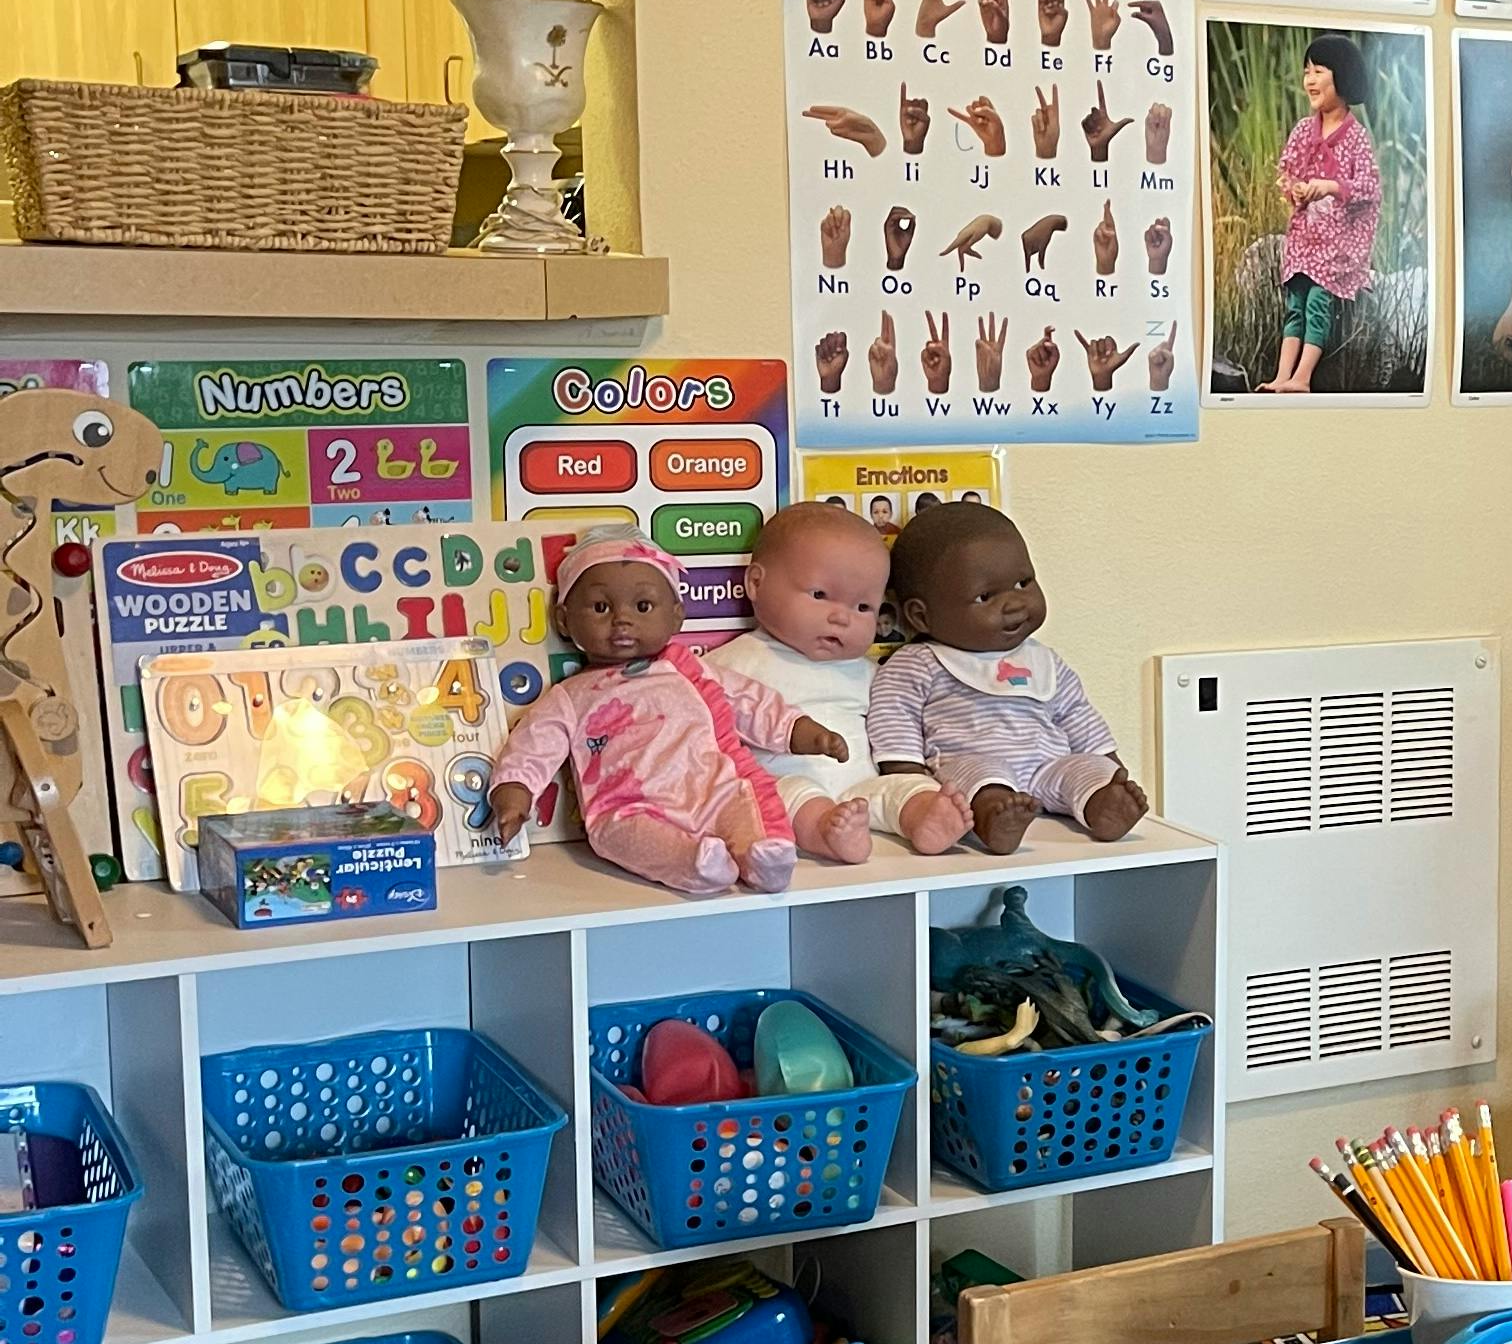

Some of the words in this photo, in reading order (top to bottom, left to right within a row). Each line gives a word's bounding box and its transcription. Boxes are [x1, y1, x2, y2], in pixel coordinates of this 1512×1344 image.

[808, 37, 840, 59] Aa
[865, 41, 894, 61] Bb
[923, 44, 951, 65] Cc
[984, 47, 1012, 68] Dd
[1041, 51, 1064, 71] Ee
[1094, 54, 1114, 74] Ff
[1146, 57, 1174, 82] Gg
[823, 159, 854, 181] Hh
[905, 161, 920, 182] Ii
[970, 165, 990, 189] Jj
[1034, 167, 1061, 187] Kk
[1092, 169, 1109, 188] Ll
[1140, 170, 1174, 191] Mm
[818, 274, 849, 295] Nn
[881, 276, 913, 296] Oo
[955, 276, 981, 301] Pp
[1025, 277, 1060, 302] Qq
[1095, 279, 1118, 298] Rr
[1150, 280, 1170, 298] Ss
[200, 369, 405, 416] Numbers
[553, 365, 735, 415] Colors
[820, 398, 841, 418] Tt
[871, 398, 900, 418] Uu
[925, 398, 952, 417] Vv
[972, 397, 1012, 417] Ww
[1032, 397, 1059, 416] Xx
[1092, 397, 1117, 420] Yy
[1150, 396, 1173, 416] Zz
[326, 438, 361, 486] 2
[558, 455, 602, 476] Red
[667, 453, 747, 478] Orange
[856, 466, 949, 486] Emotions
[151, 490, 186, 506] One
[327, 485, 361, 502] Two
[675, 517, 743, 539] Green
[113, 590, 251, 618] WOODEN
[679, 579, 745, 605] Purple
[144, 614, 228, 634] PUZZLE
[336, 858, 422, 875] Lenticular
[352, 847, 405, 862] Puzzle
